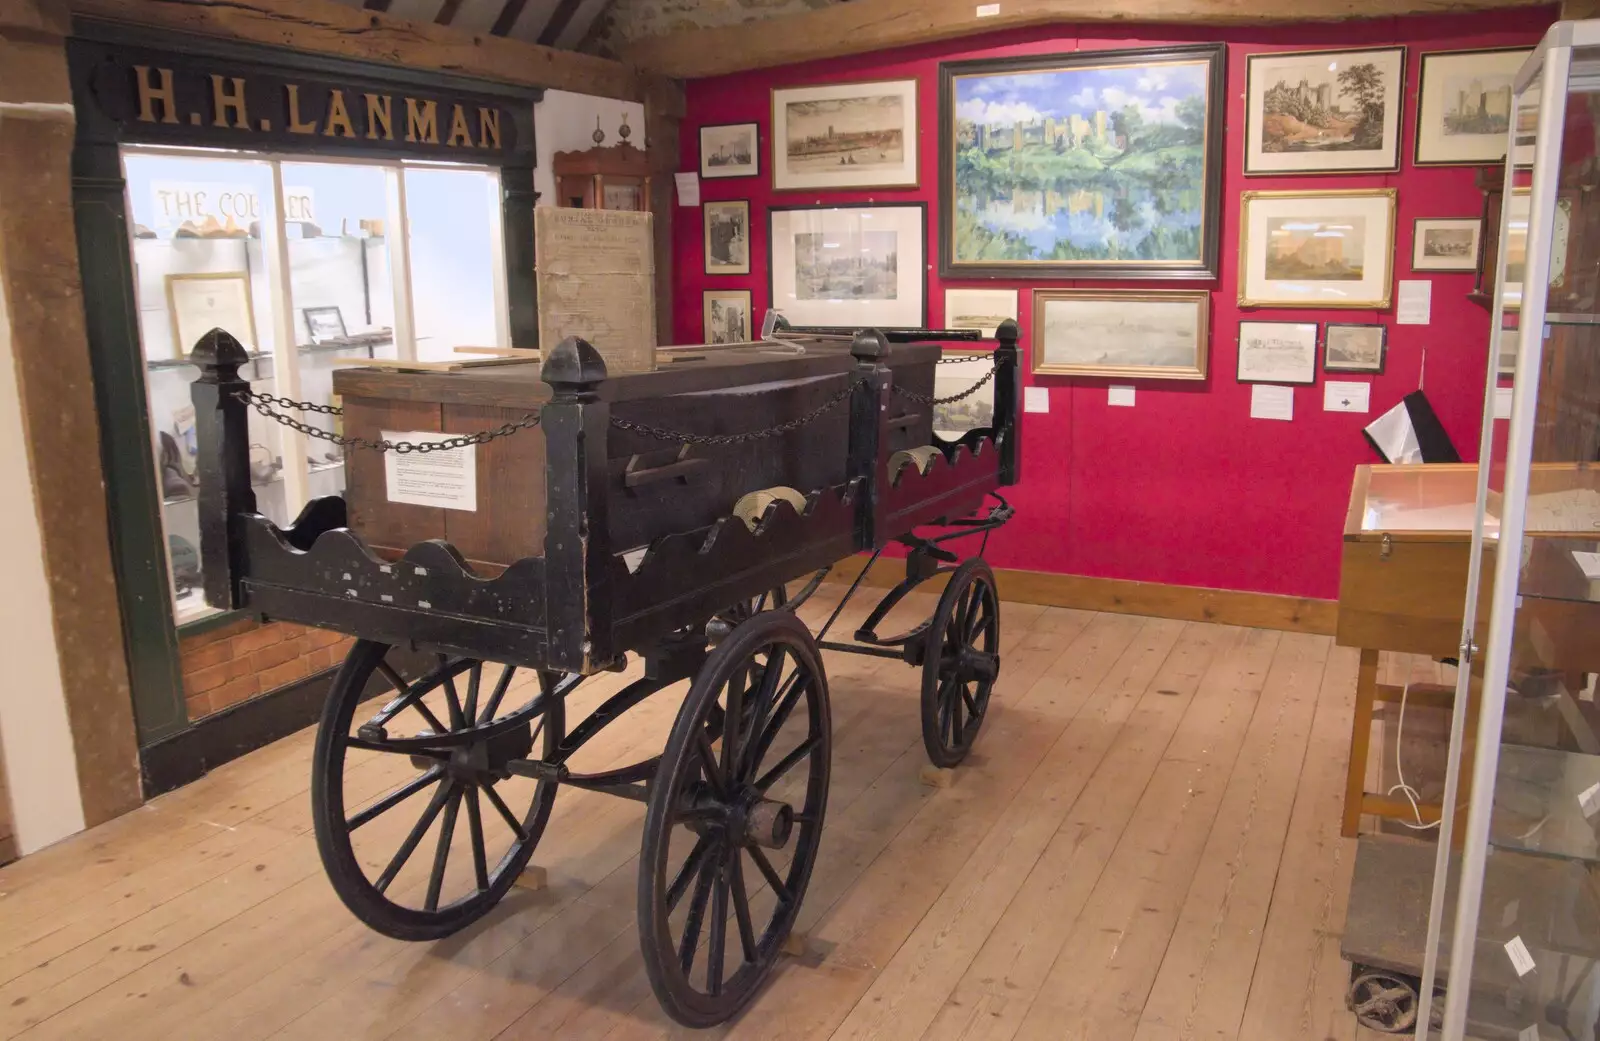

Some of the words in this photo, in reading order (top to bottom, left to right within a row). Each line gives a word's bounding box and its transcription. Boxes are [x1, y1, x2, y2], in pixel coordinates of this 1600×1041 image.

[284, 83, 502, 149] LANMAN
[157, 189, 209, 217] THE
[218, 192, 313, 219] COBER
